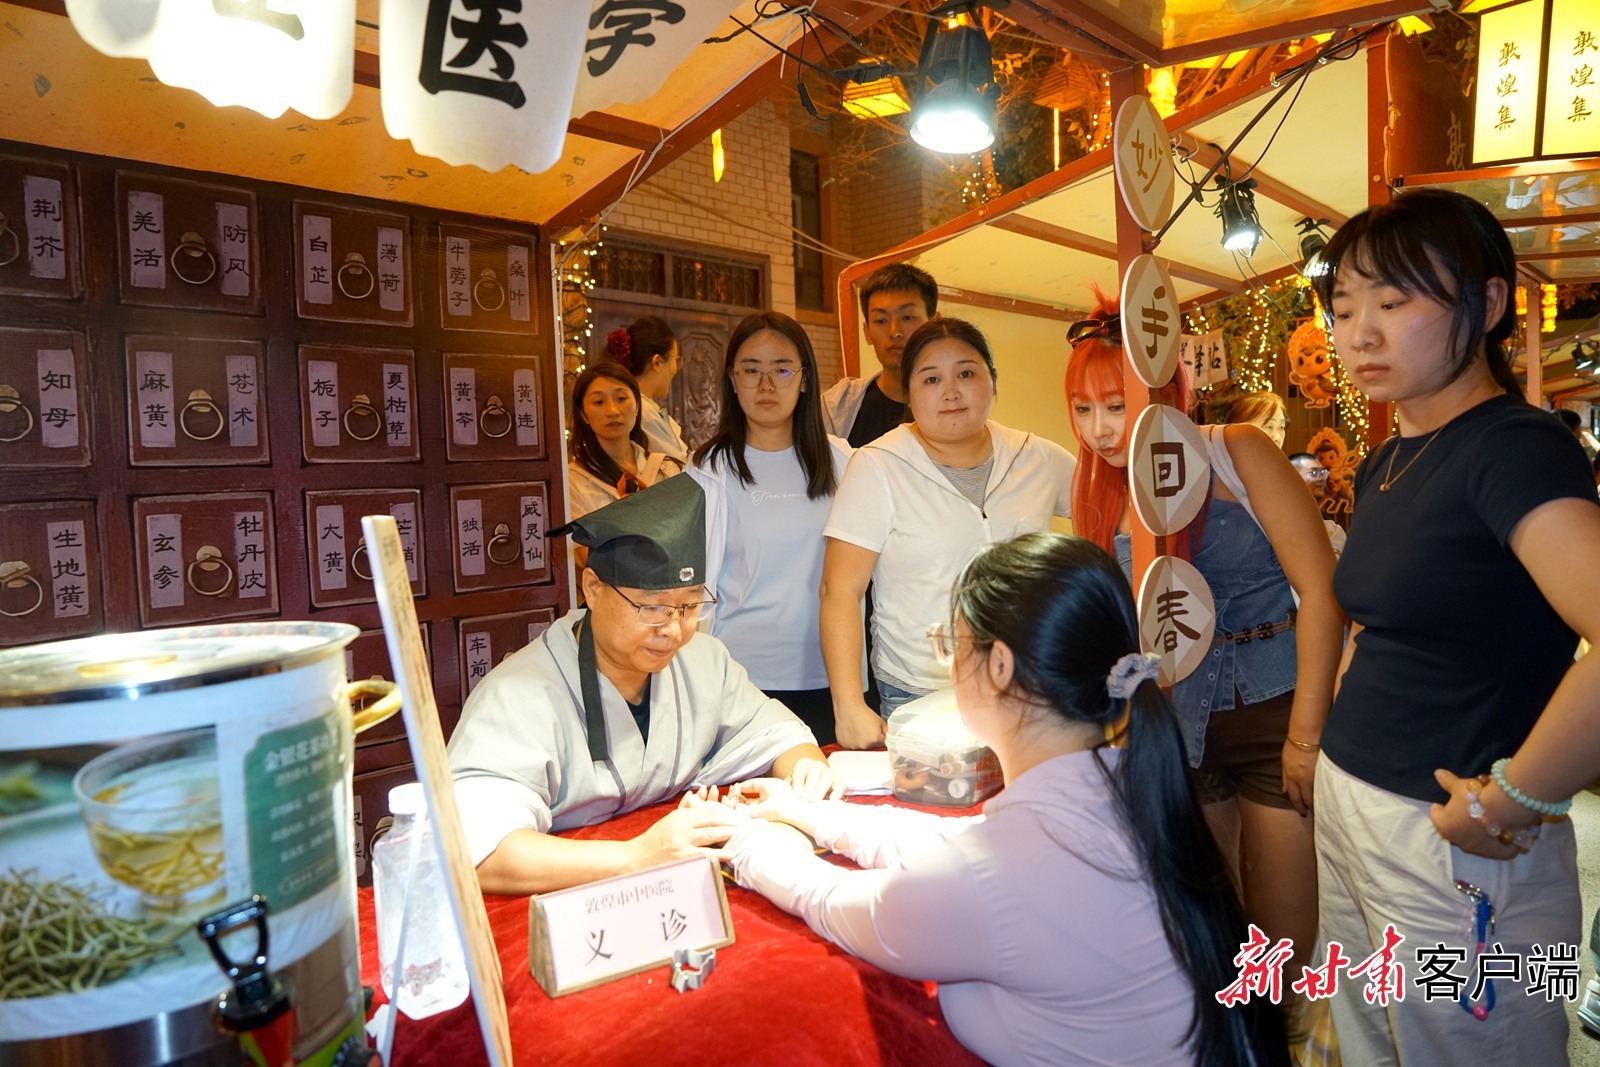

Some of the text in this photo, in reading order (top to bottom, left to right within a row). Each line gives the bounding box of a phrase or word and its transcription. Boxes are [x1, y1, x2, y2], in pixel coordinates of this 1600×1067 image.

[419, 0, 528, 109] 医
[1568, 31, 1599, 122] 敦煌集
[1494, 42, 1521, 131] 敦煌集
[31, 199, 64, 258] 荆芥
[131, 211, 162, 268] 羌活
[223, 224, 250, 277] 防风
[309, 236, 329, 285] 白芷
[380, 243, 400, 292] 薄荷
[509, 260, 525, 305] 桑叶
[41, 370, 76, 428] 知母
[140, 370, 169, 428] 麻黄
[229, 373, 255, 426] 苍术
[311, 379, 338, 428] 栀子
[385, 371, 407, 440] 夏枯草
[516, 384, 535, 430] 黄连
[236, 515, 266, 591] 牡丹皮
[321, 523, 344, 573] 大黄
[462, 519, 482, 557] 独活
[522, 502, 543, 561] 威灵仙
[52, 529, 86, 611] 生地黄
[152, 534, 180, 590] 玄参
[585, 877, 675, 915] 敦煌市中医院
